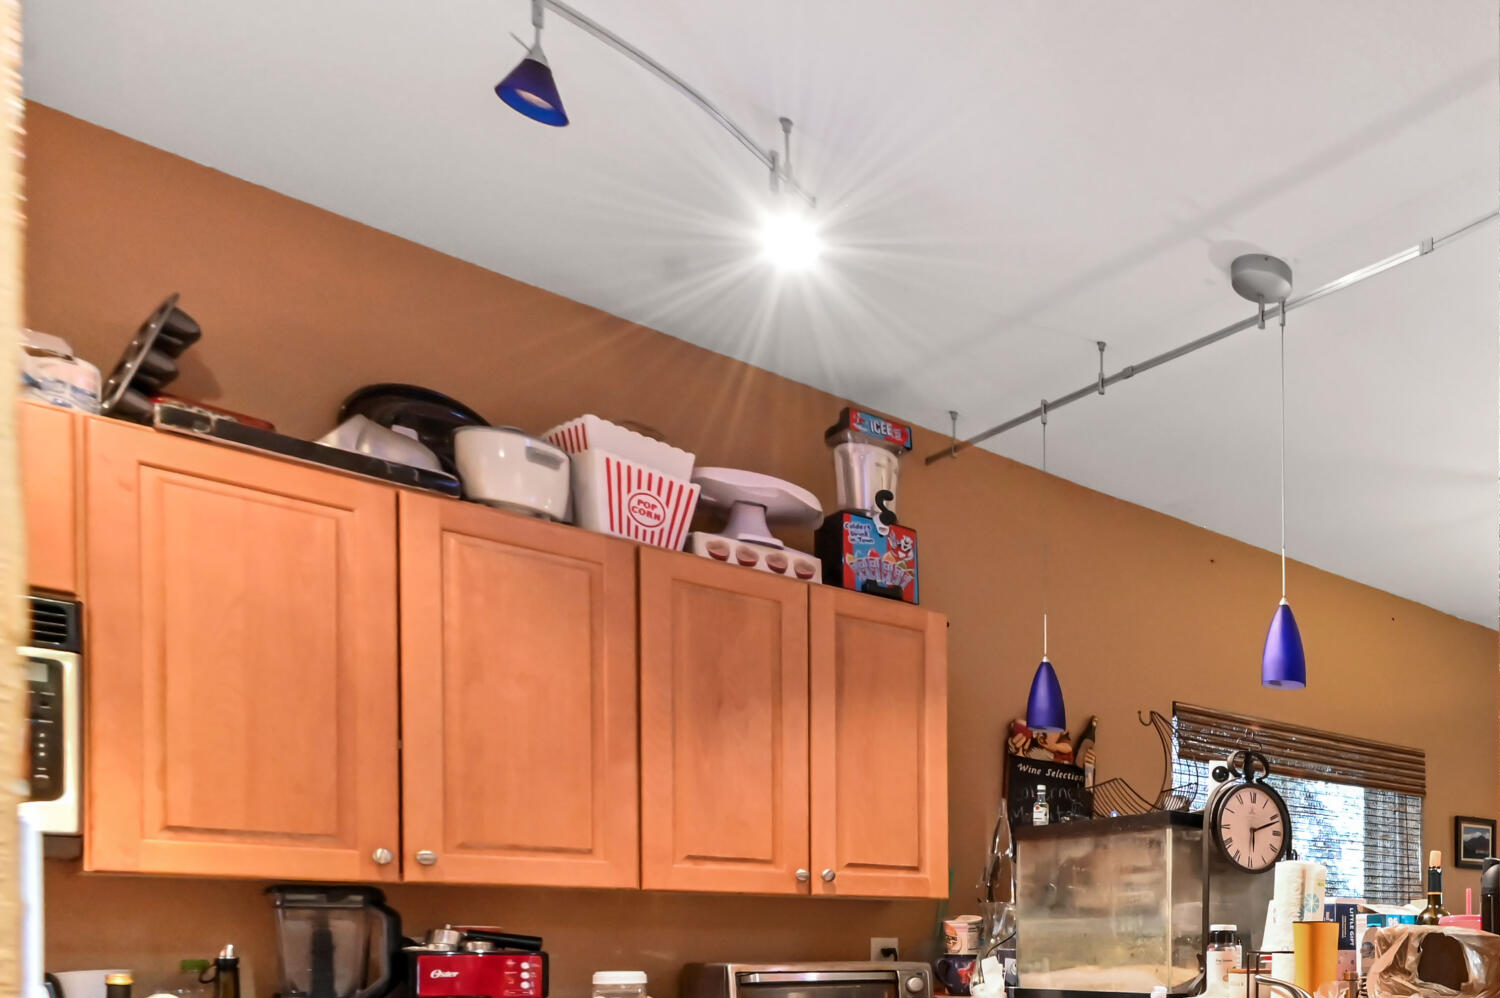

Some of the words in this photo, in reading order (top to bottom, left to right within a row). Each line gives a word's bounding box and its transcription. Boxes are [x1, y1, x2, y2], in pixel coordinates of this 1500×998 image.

[871, 420, 892, 436] ICEE
[637, 499, 657, 510] POP
[631, 505, 661, 521] CORN
[1017, 763, 1042, 775] Wine
[1045, 768, 1085, 782] Selection
[430, 969, 459, 979] Oster
